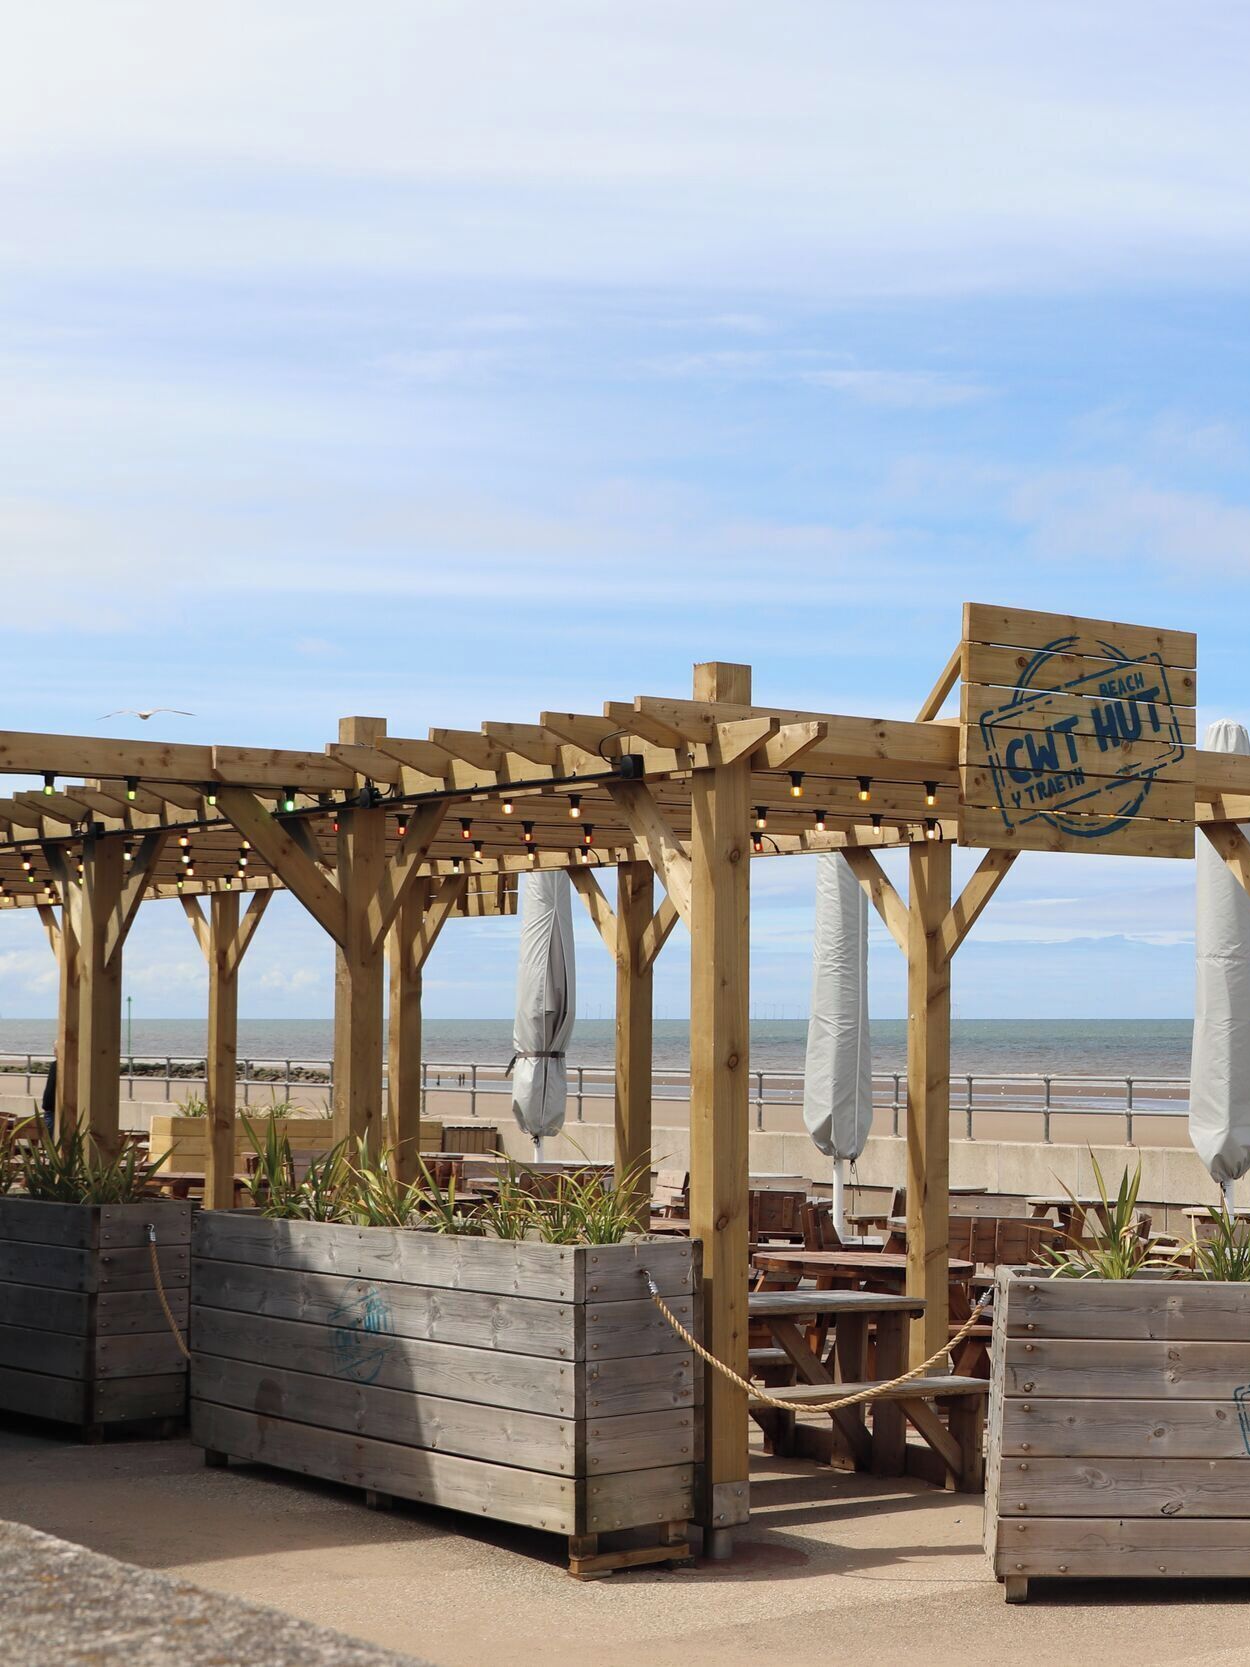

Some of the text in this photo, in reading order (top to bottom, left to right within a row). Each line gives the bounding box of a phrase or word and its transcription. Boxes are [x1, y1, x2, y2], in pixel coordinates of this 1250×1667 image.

[1098, 672, 1145, 697] BEACH
[1006, 687, 1160, 784] CWT HUT
[1011, 768, 1085, 809] Y TRAETH
